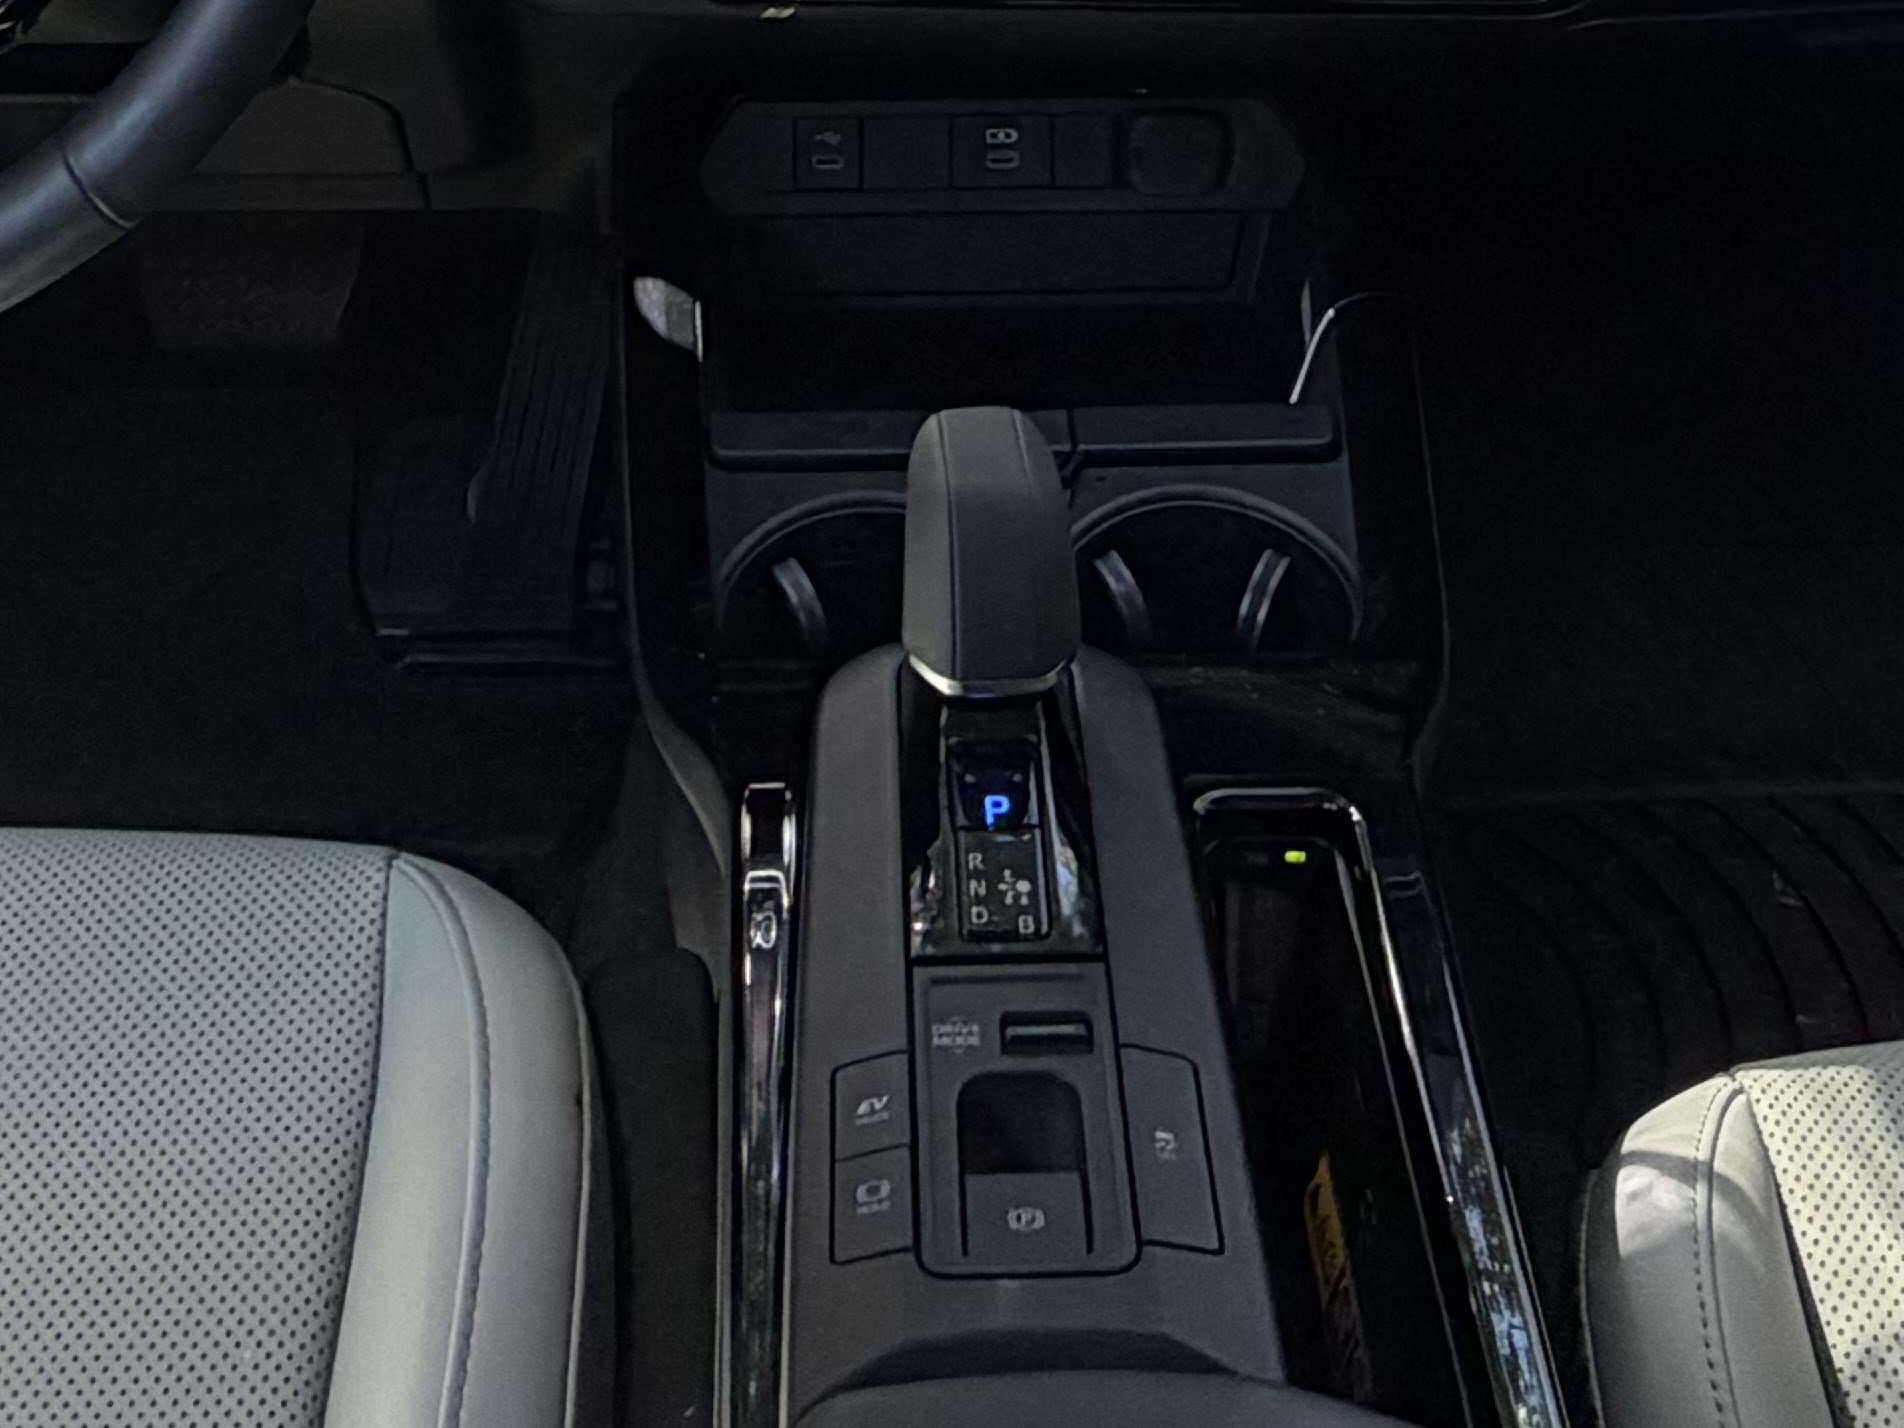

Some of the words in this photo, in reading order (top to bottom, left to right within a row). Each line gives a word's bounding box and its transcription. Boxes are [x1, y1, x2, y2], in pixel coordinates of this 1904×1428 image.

[984, 794, 1010, 828] P
[968, 852, 985, 871] R
[969, 879, 987, 897] N
[970, 905, 989, 925] D
[1018, 914, 1036, 934] B
[932, 1023, 980, 1035] DRIVE
